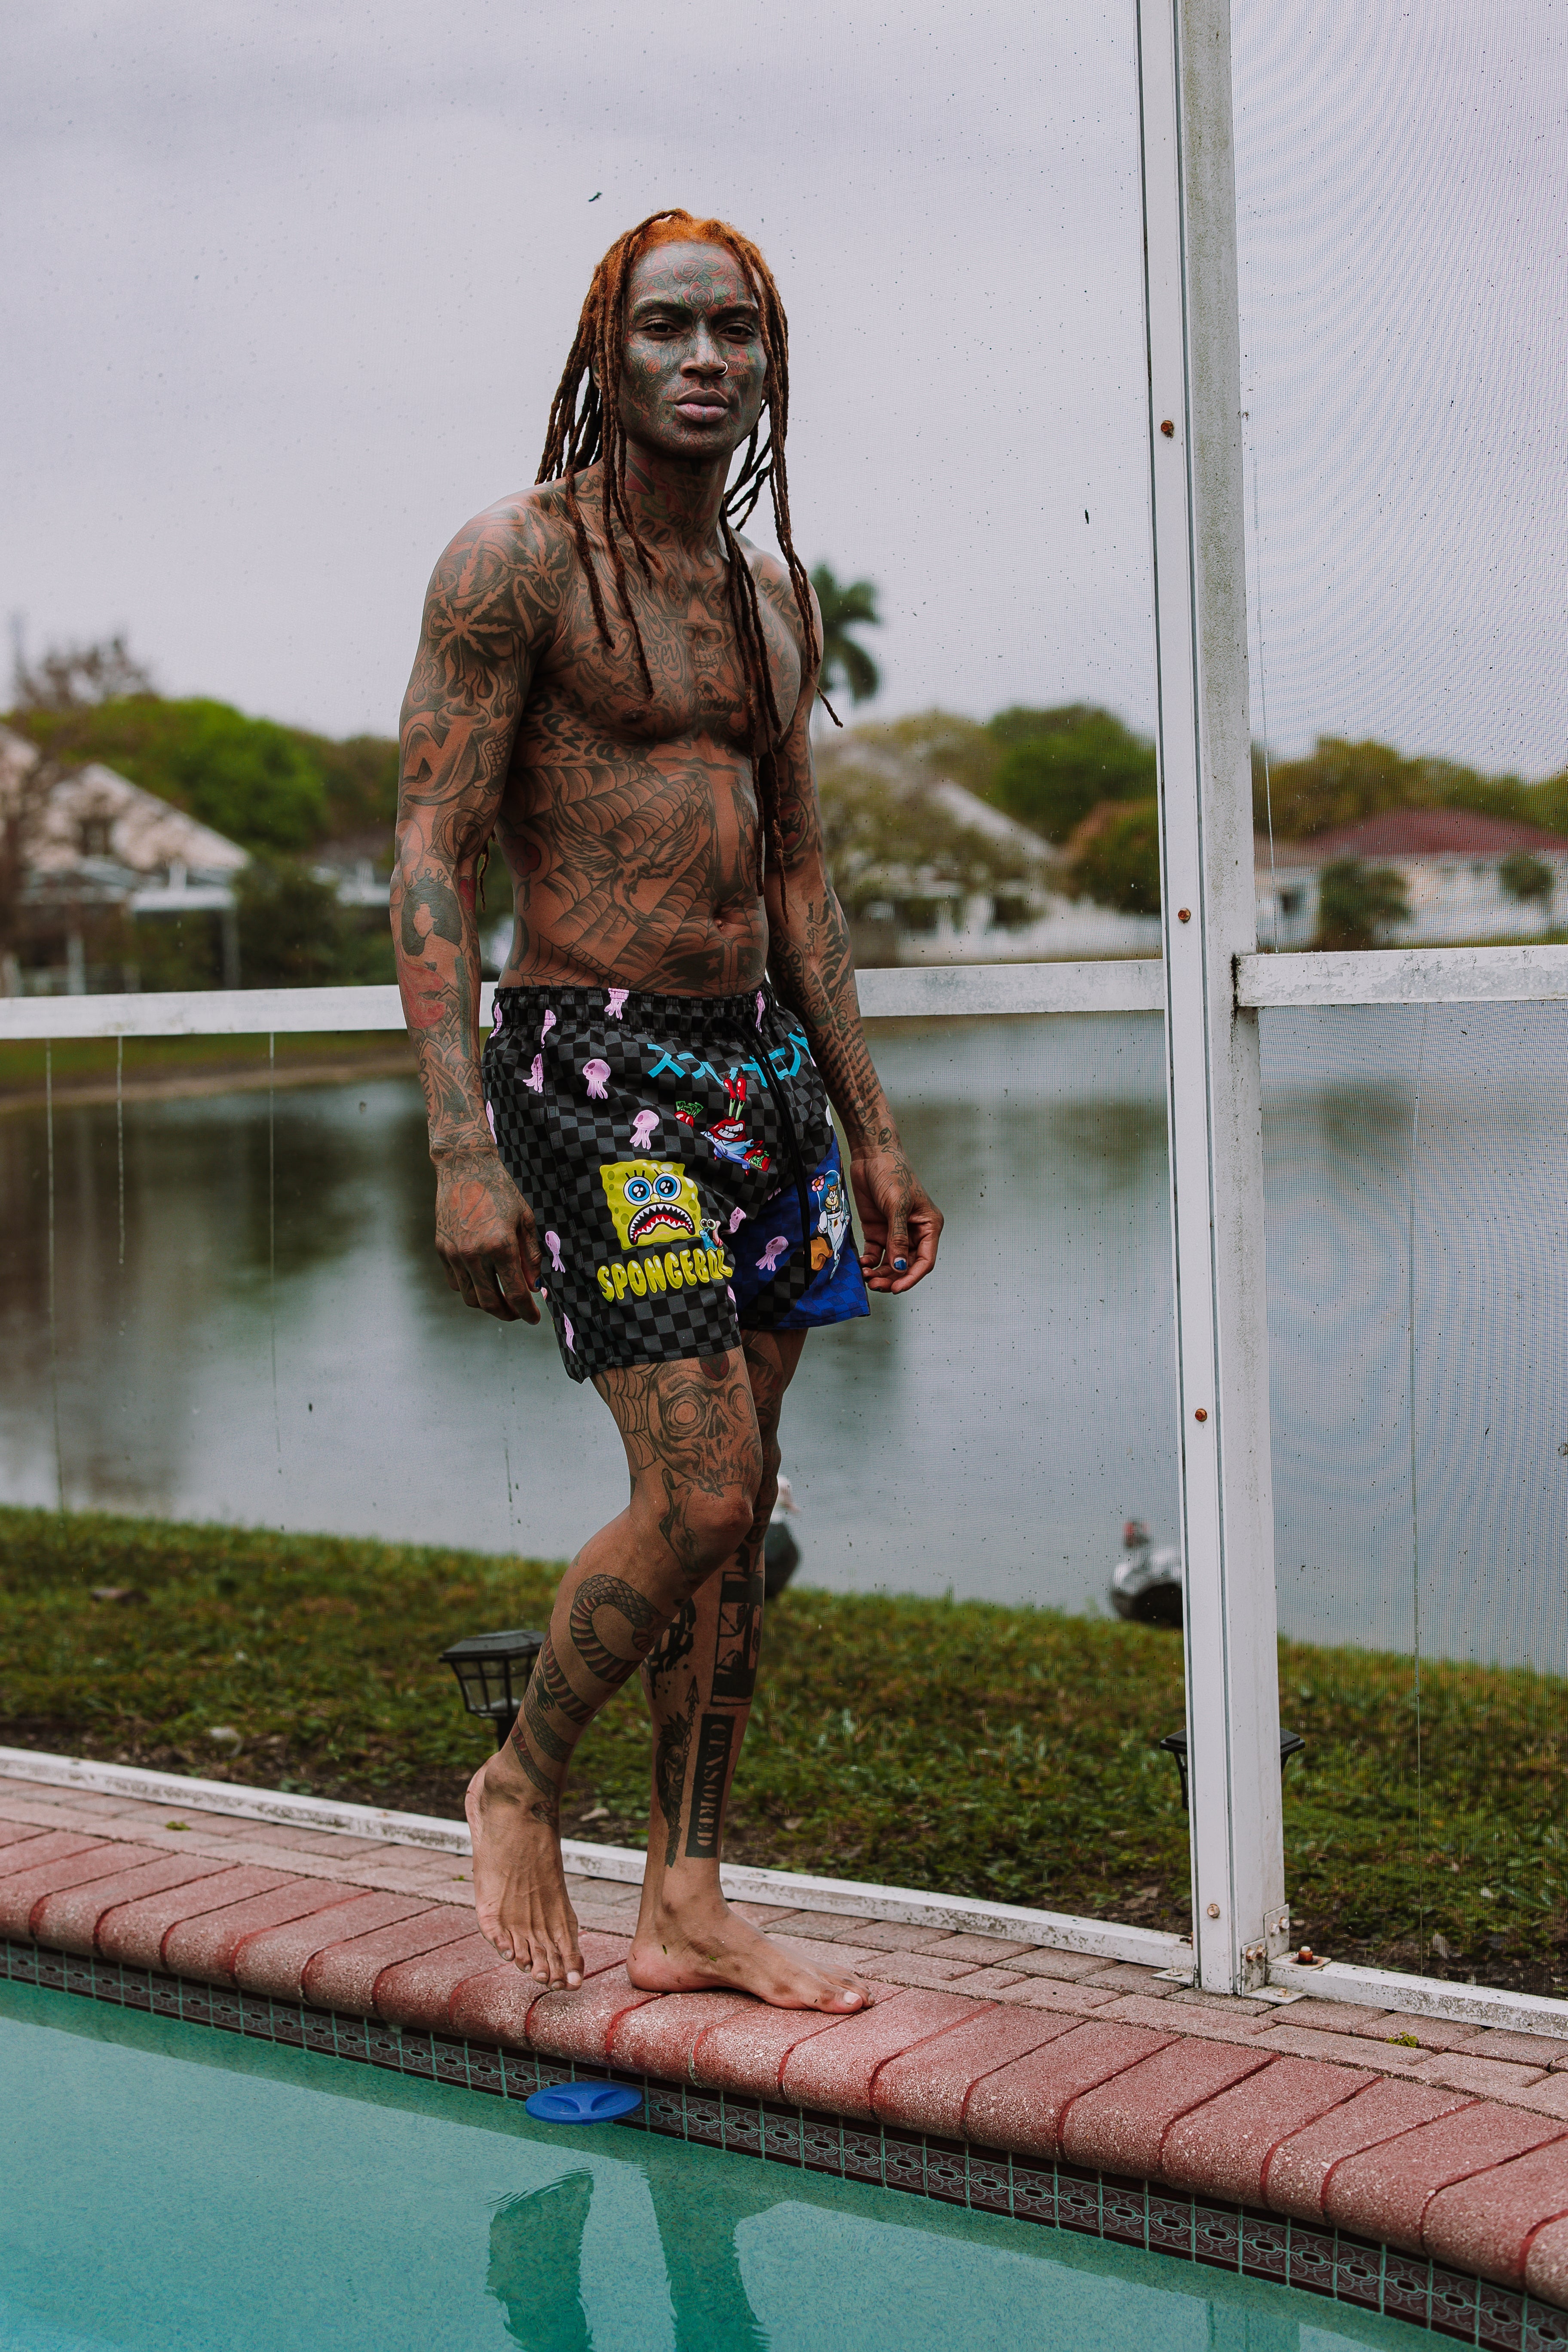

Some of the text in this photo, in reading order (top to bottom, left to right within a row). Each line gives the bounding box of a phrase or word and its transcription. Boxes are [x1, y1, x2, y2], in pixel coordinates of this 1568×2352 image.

[773, 936, 807, 1002] AIR JORDAN
[696, 1723, 728, 1847] CENSORED
